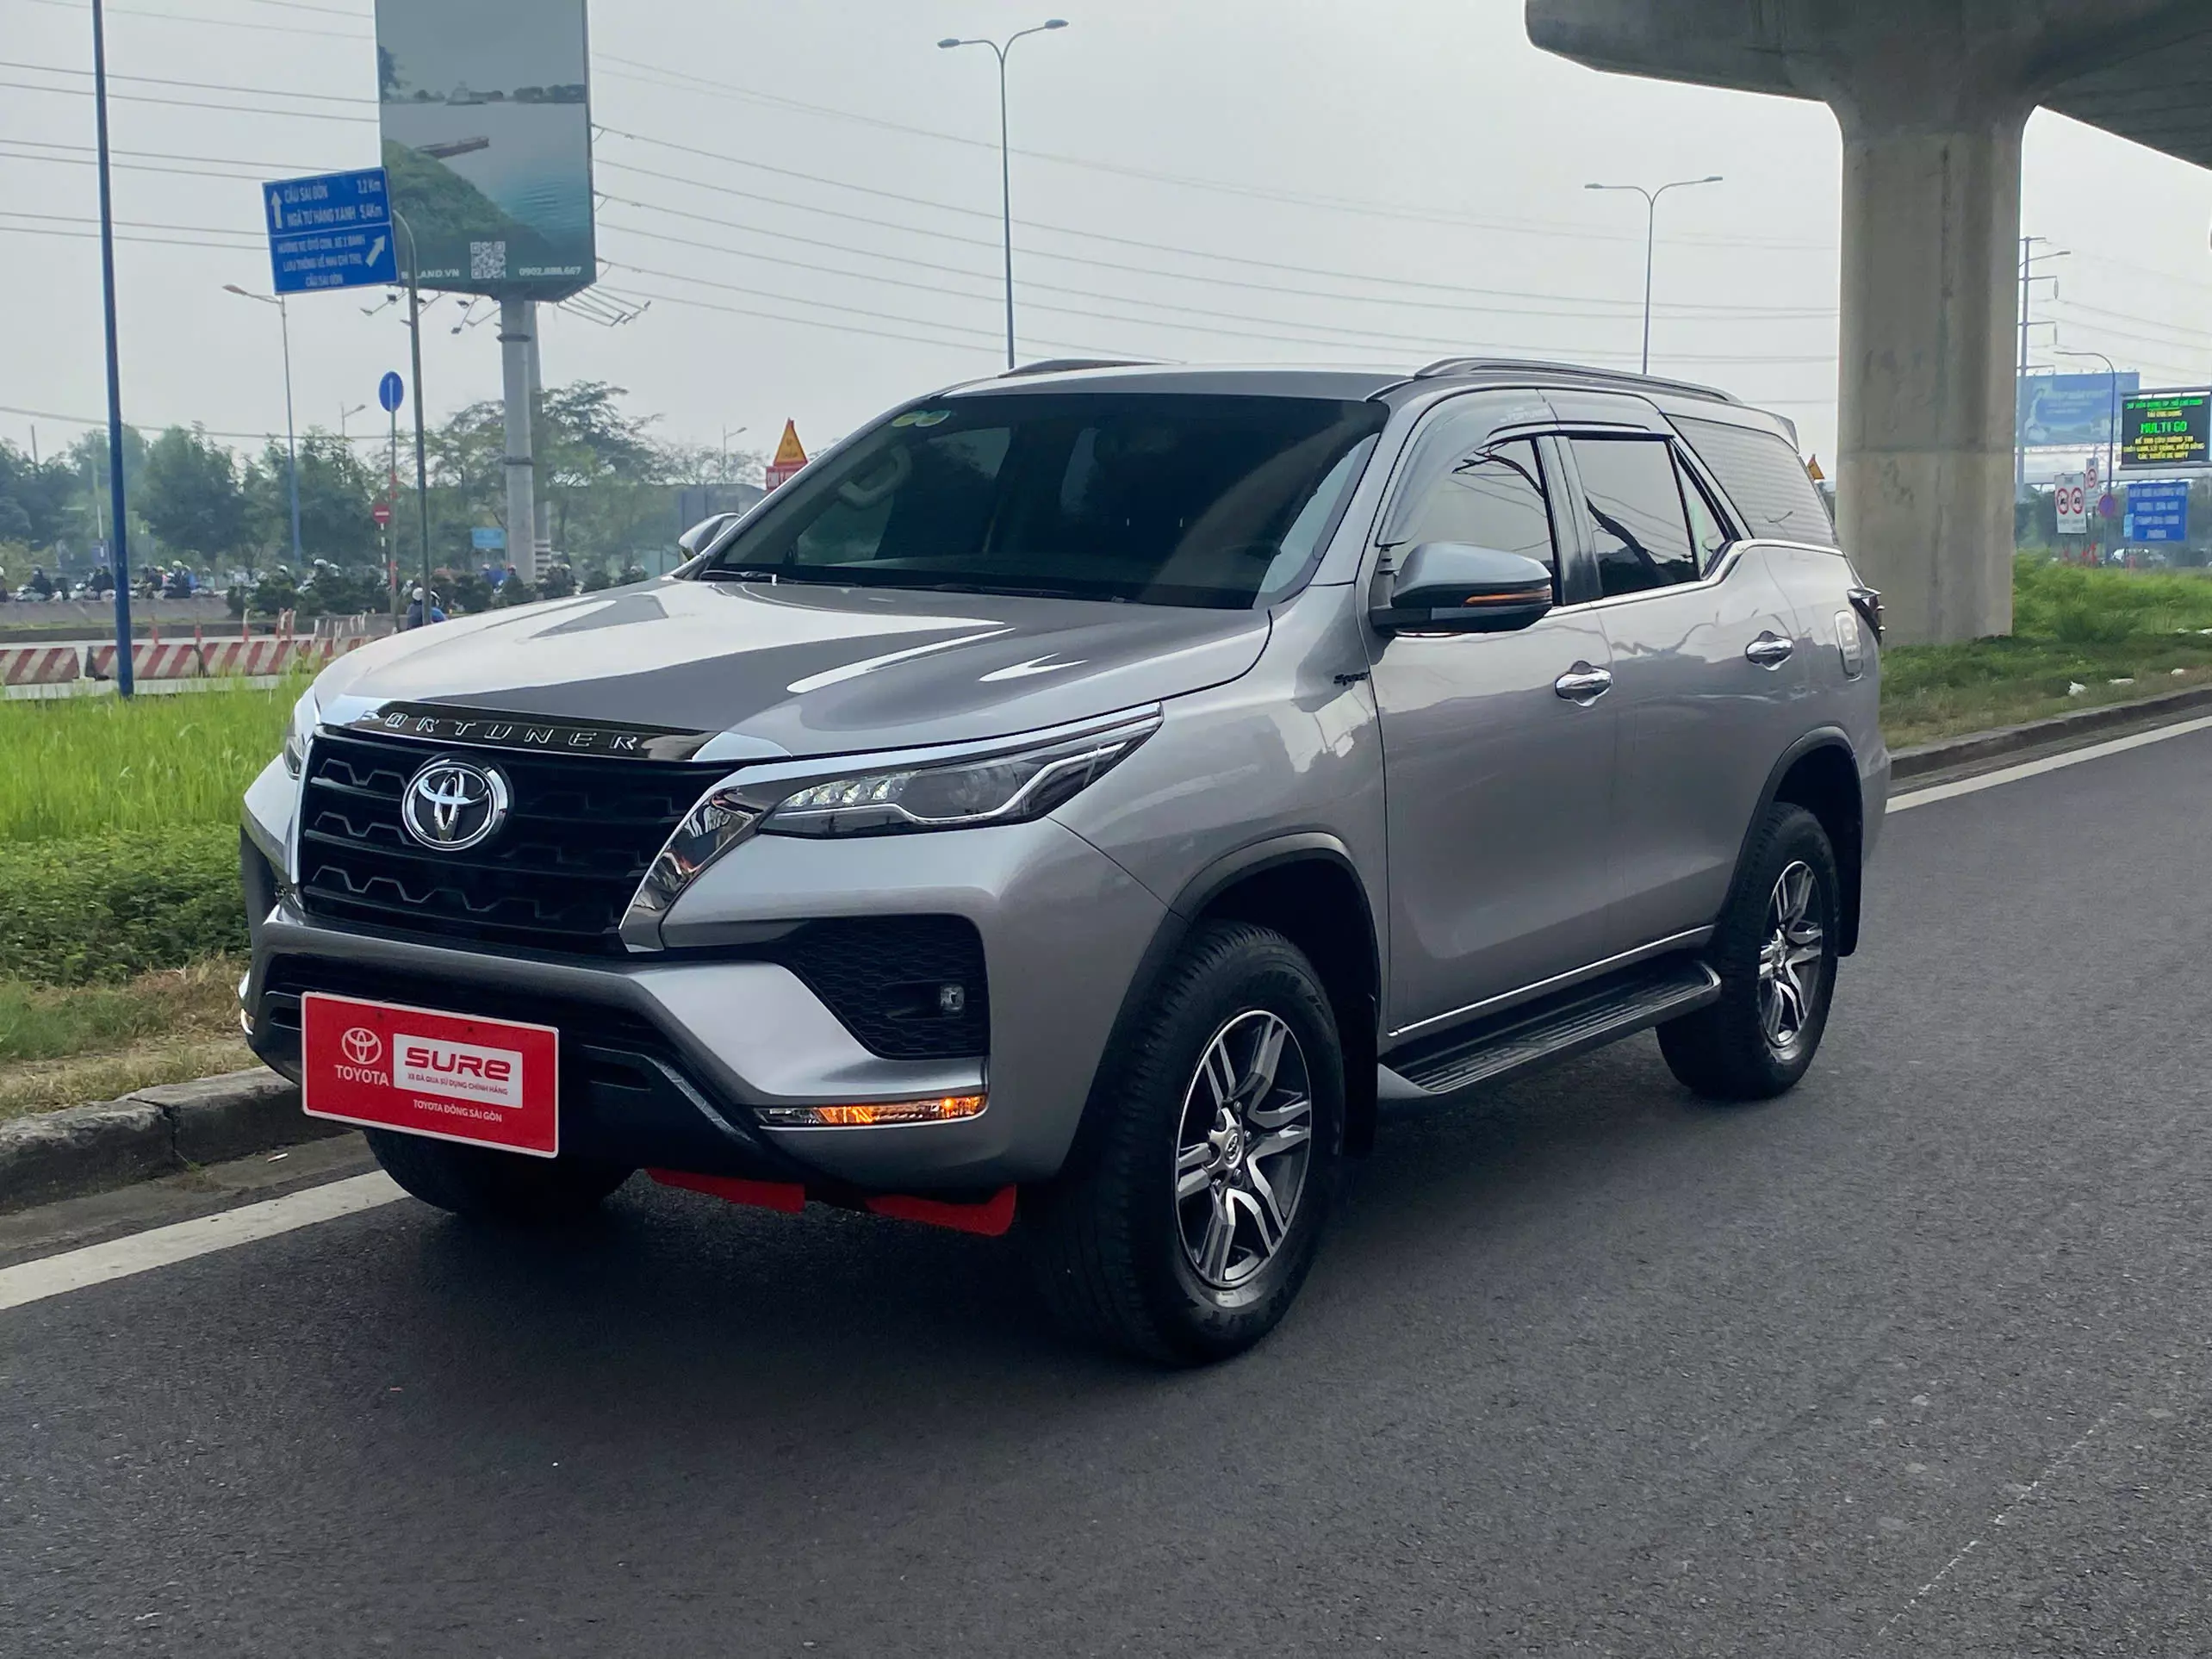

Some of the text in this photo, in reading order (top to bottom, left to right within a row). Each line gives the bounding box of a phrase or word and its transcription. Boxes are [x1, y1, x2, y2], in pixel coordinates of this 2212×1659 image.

[333, 1064, 390, 1087] TOYOTA
[413, 1099, 444, 1113] TOYOTA
[483, 1109, 502, 1123] GÒN
